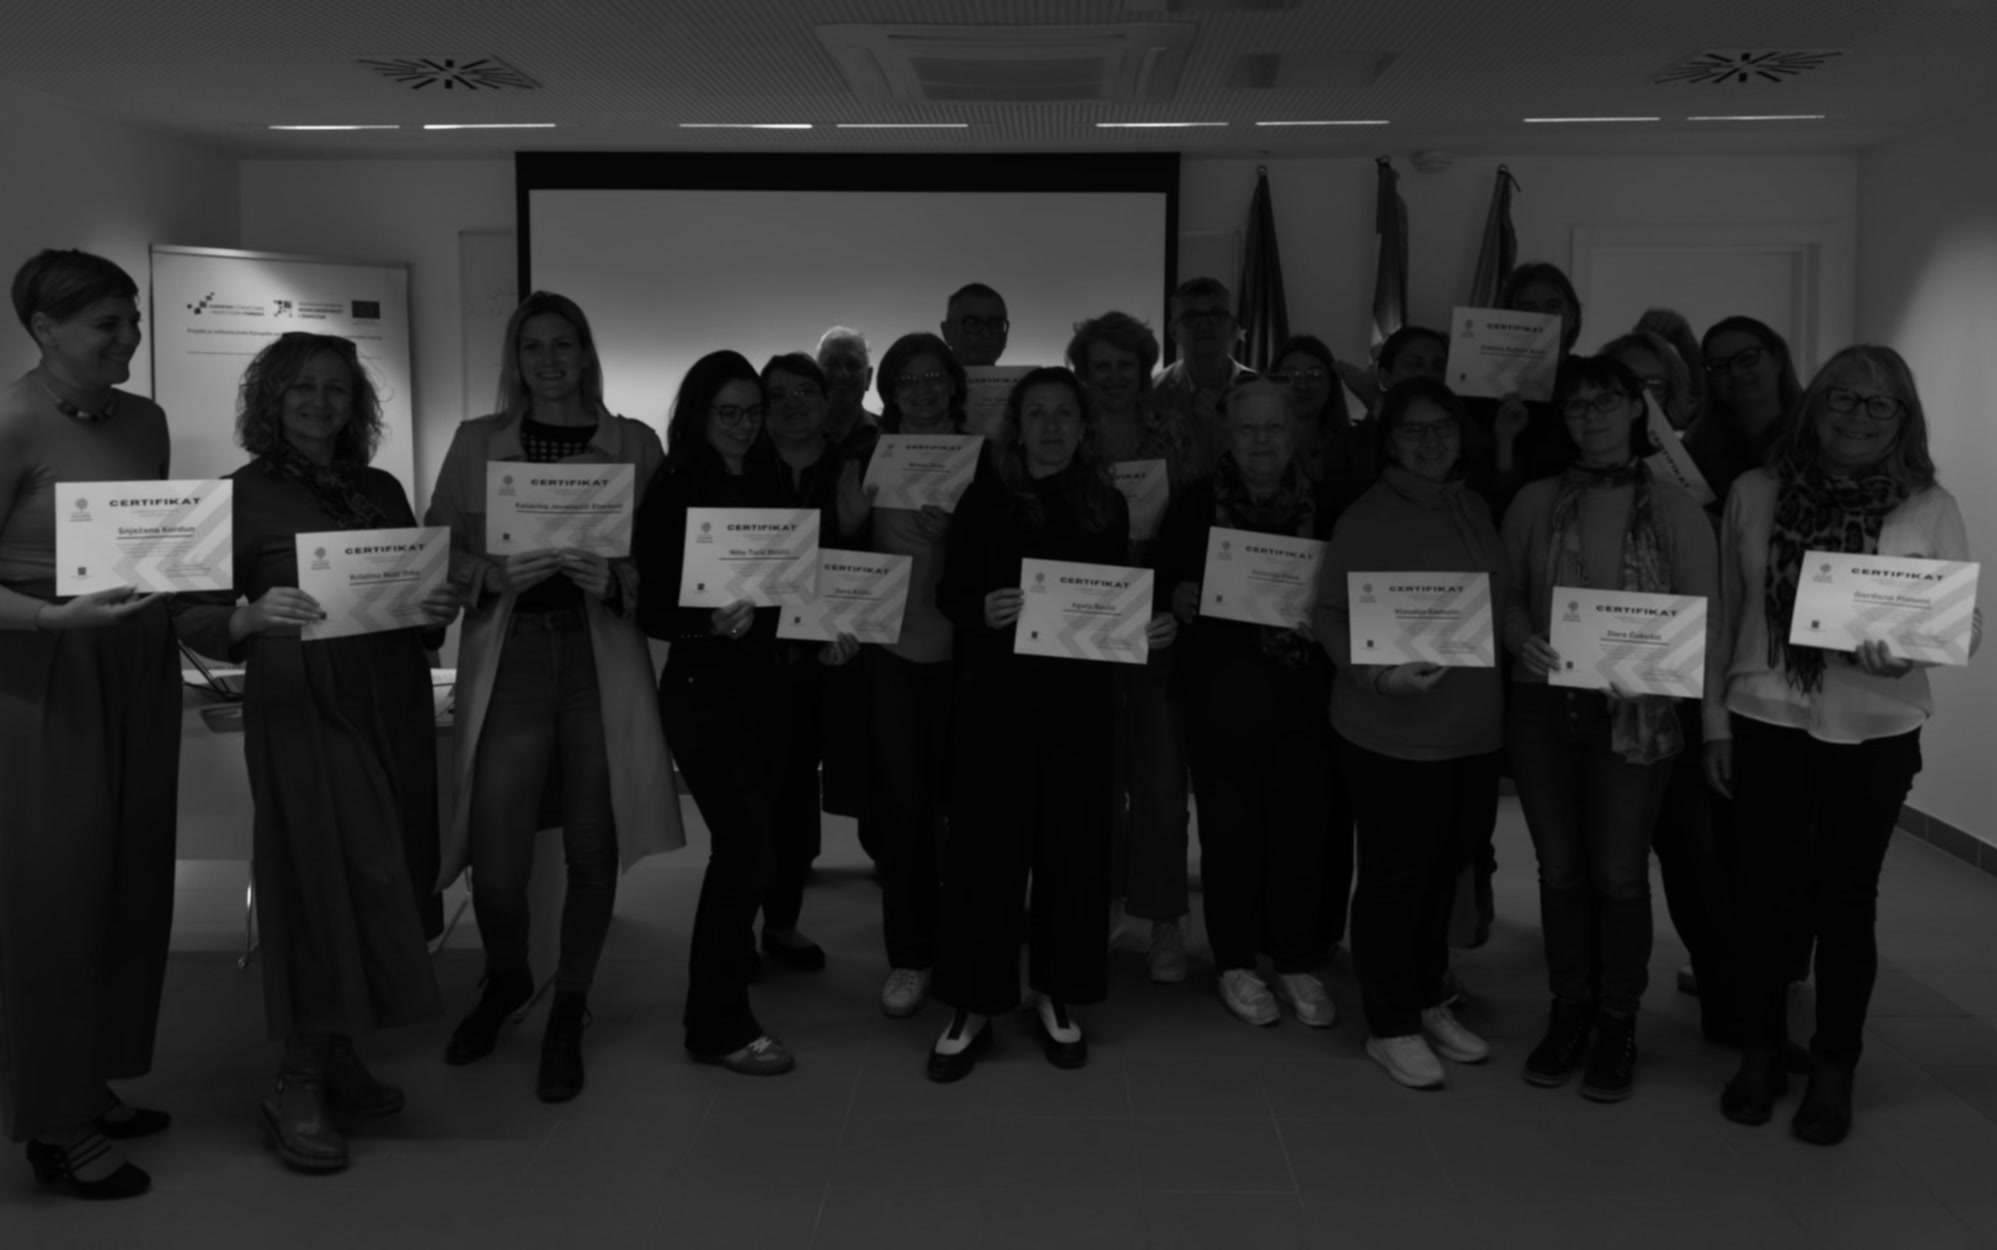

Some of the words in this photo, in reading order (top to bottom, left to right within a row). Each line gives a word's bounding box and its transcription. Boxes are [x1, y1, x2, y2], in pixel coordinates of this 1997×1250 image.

[109, 497, 201, 507] CERTIFIKAT
[345, 543, 425, 554] CERTIFIKAT
[1245, 545, 1313, 560] CERTIFIKAT
[824, 563, 889, 575] CERTIFIKAT
[1851, 567, 1944, 582] CERTIFIKAT
[1060, 576, 1130, 588] CERTIFIKAT
[1596, 604, 1678, 617] CERTIFIKAT
